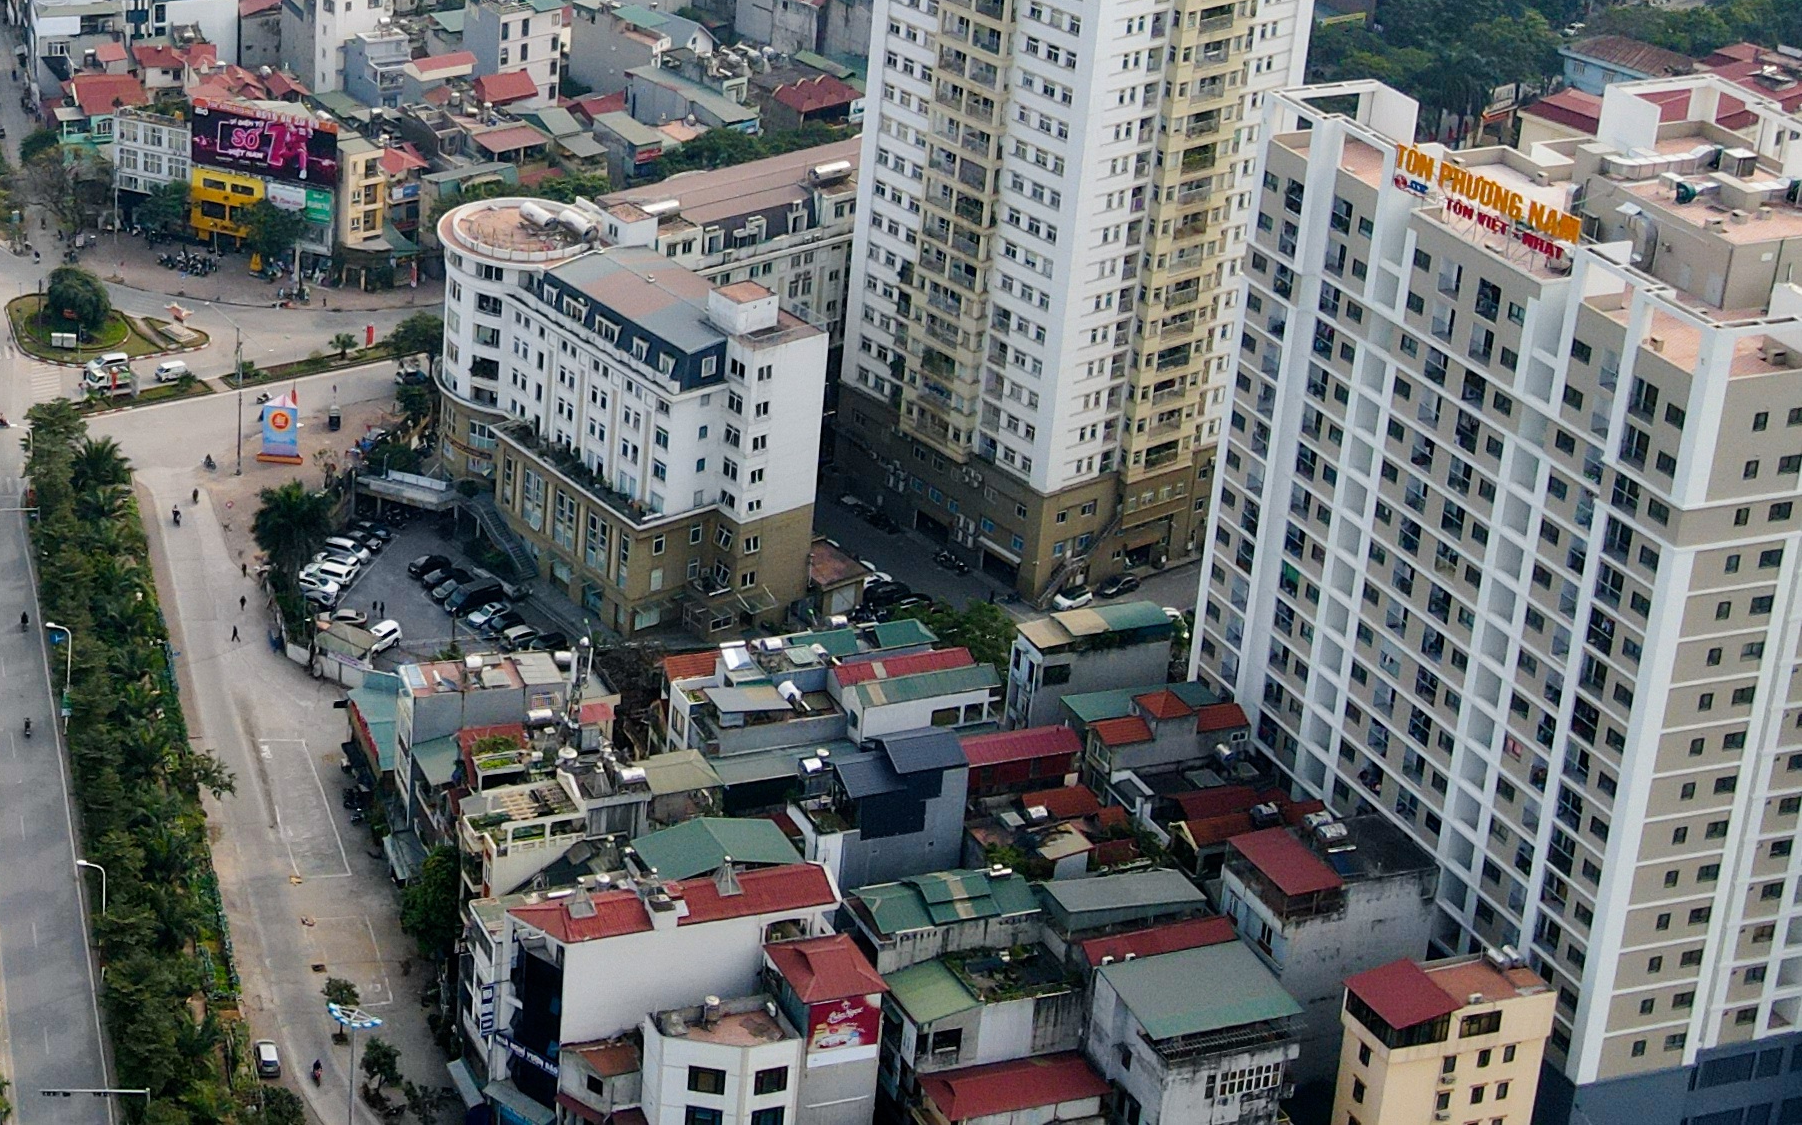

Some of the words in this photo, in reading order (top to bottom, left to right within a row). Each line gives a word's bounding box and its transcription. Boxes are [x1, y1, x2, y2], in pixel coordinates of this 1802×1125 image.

[231, 127, 263, 150] SỐ
[1395, 143, 1435, 182] TÔN
[1438, 161, 1523, 221] PHƯƠNG
[1528, 199, 1582, 244] NAM
